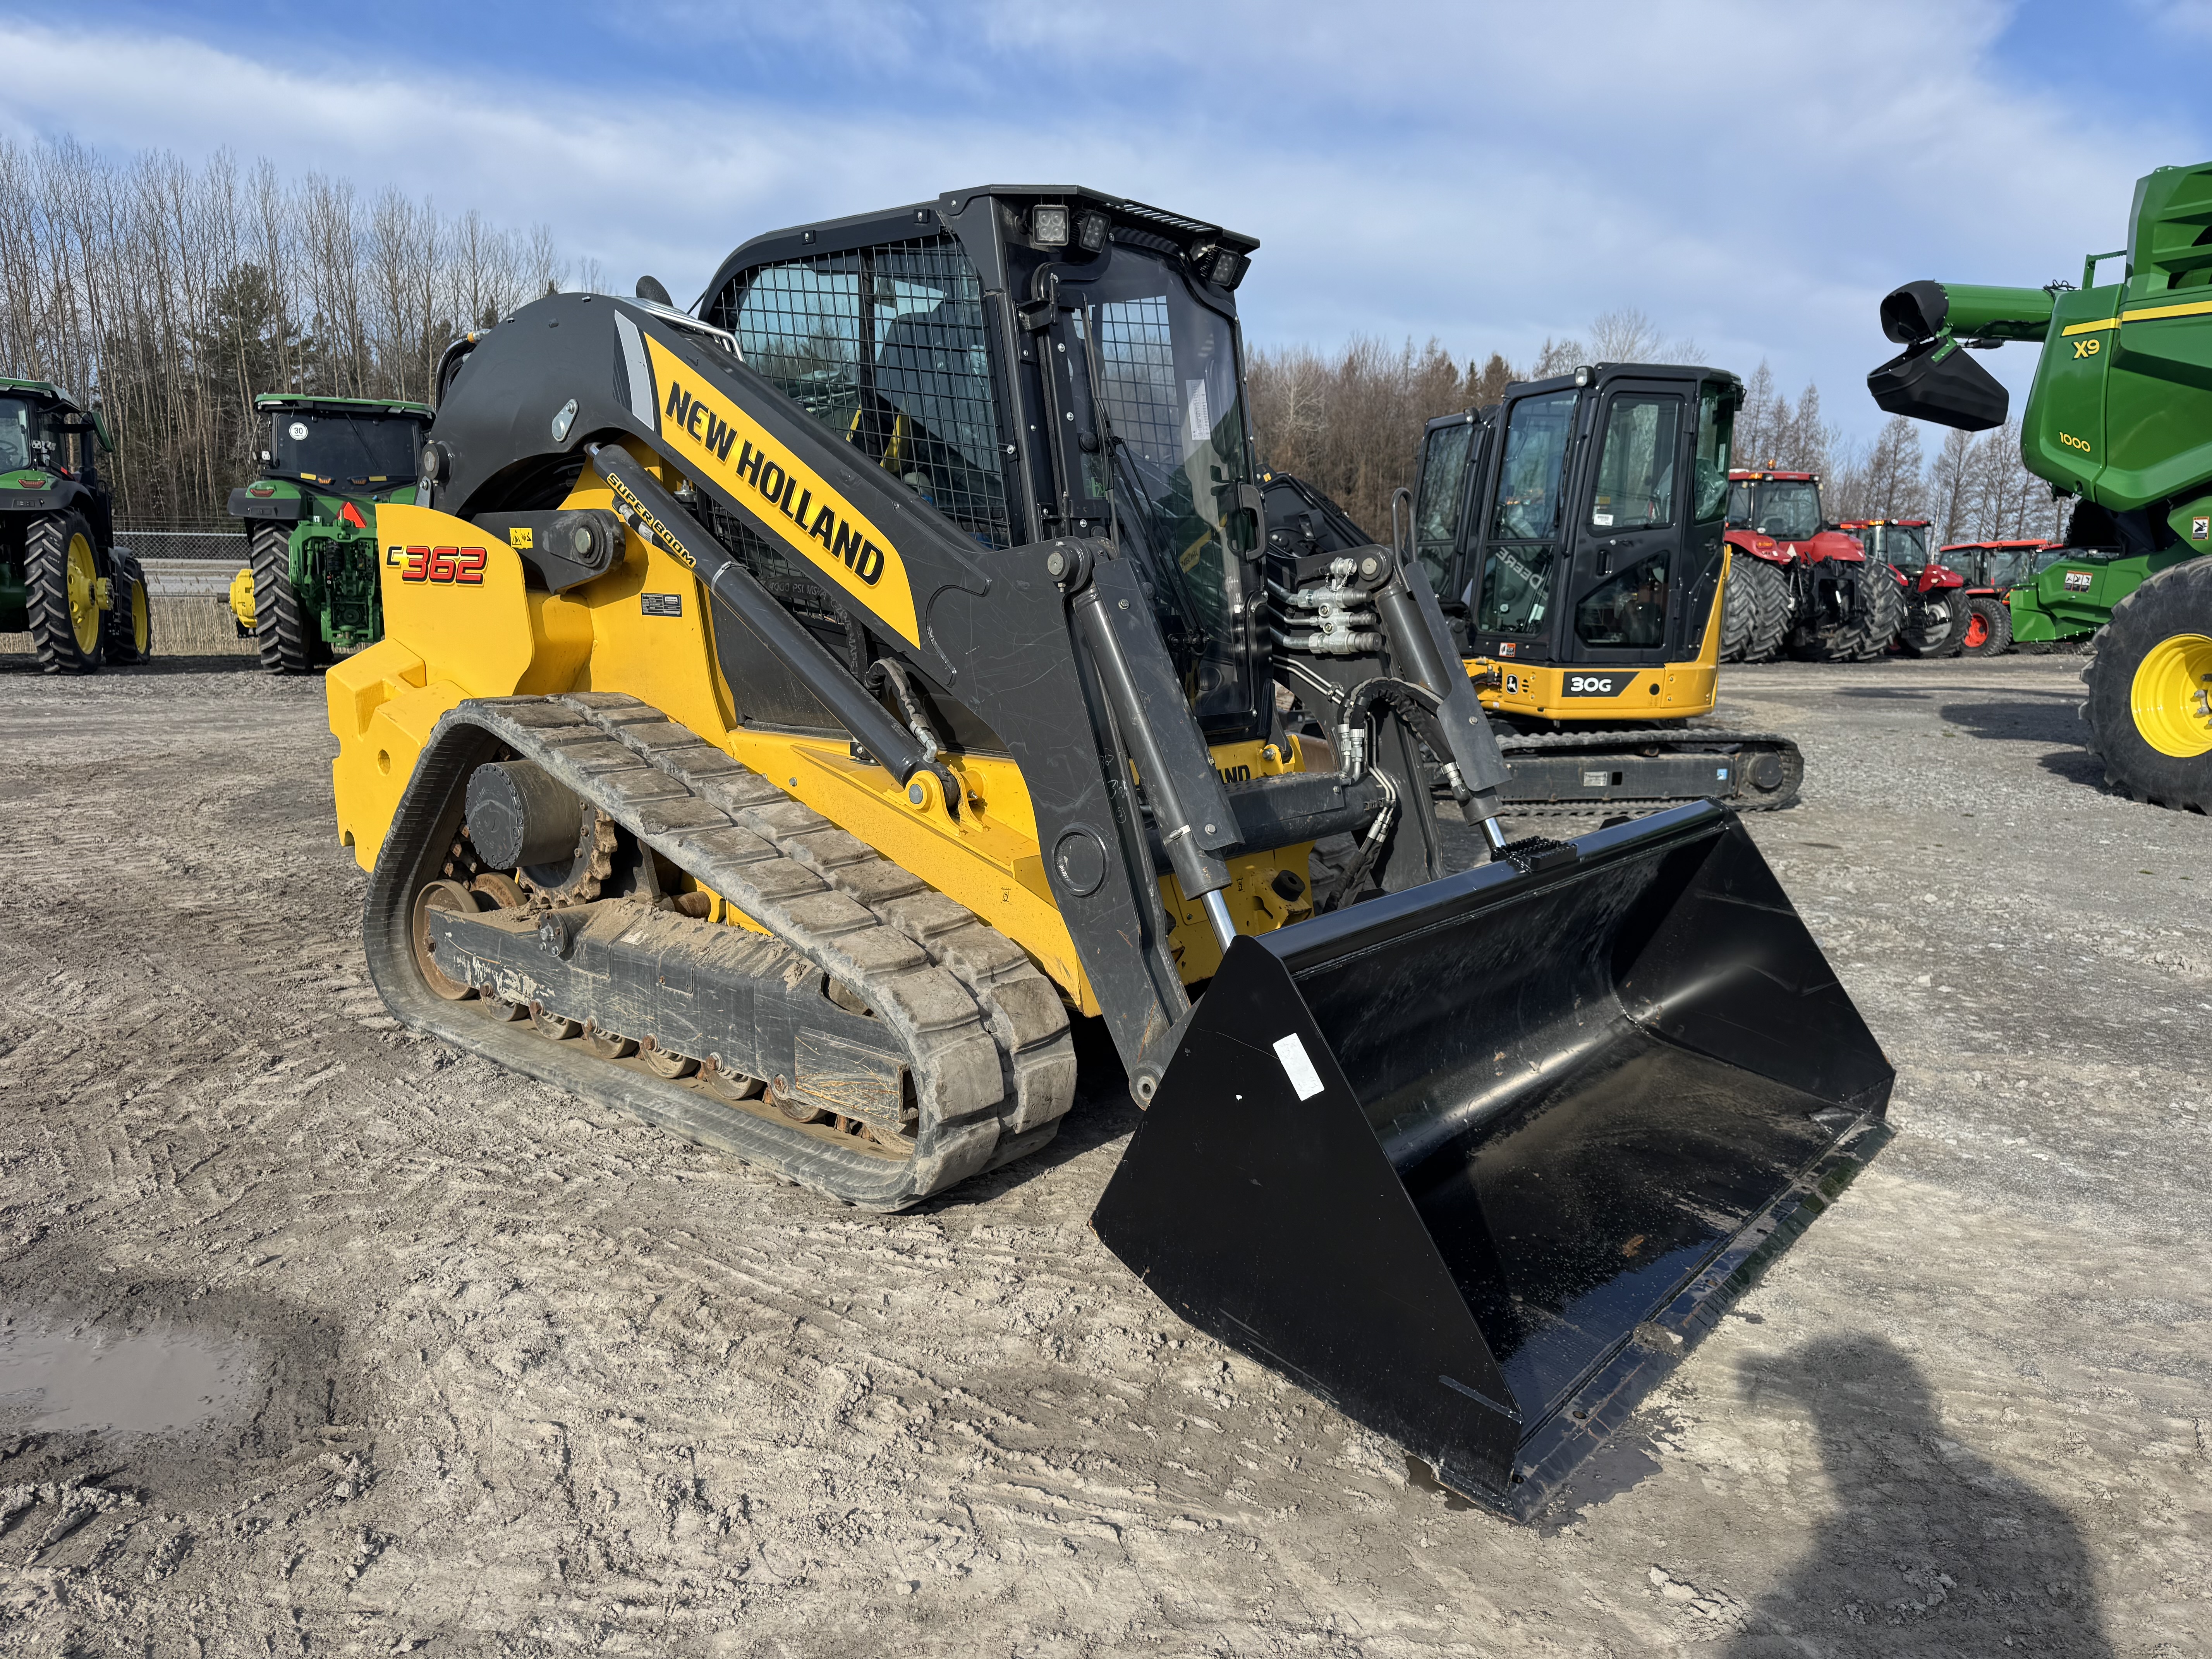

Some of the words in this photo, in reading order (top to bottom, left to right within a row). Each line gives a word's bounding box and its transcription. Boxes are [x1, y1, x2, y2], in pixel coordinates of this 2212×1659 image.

[2073, 339, 2100, 359] X9
[2059, 431, 2091, 452] 1000
[665, 380, 737, 463] NEW
[736, 439, 885, 586] HOLLAND
[608, 473, 654, 525] SUPER
[653, 520, 696, 567] BOOM
[769, 582, 790, 592] 4000
[793, 583, 804, 593] PSI
[806, 584, 828, 600] MSHA
[1570, 677, 1612, 692] 30G
